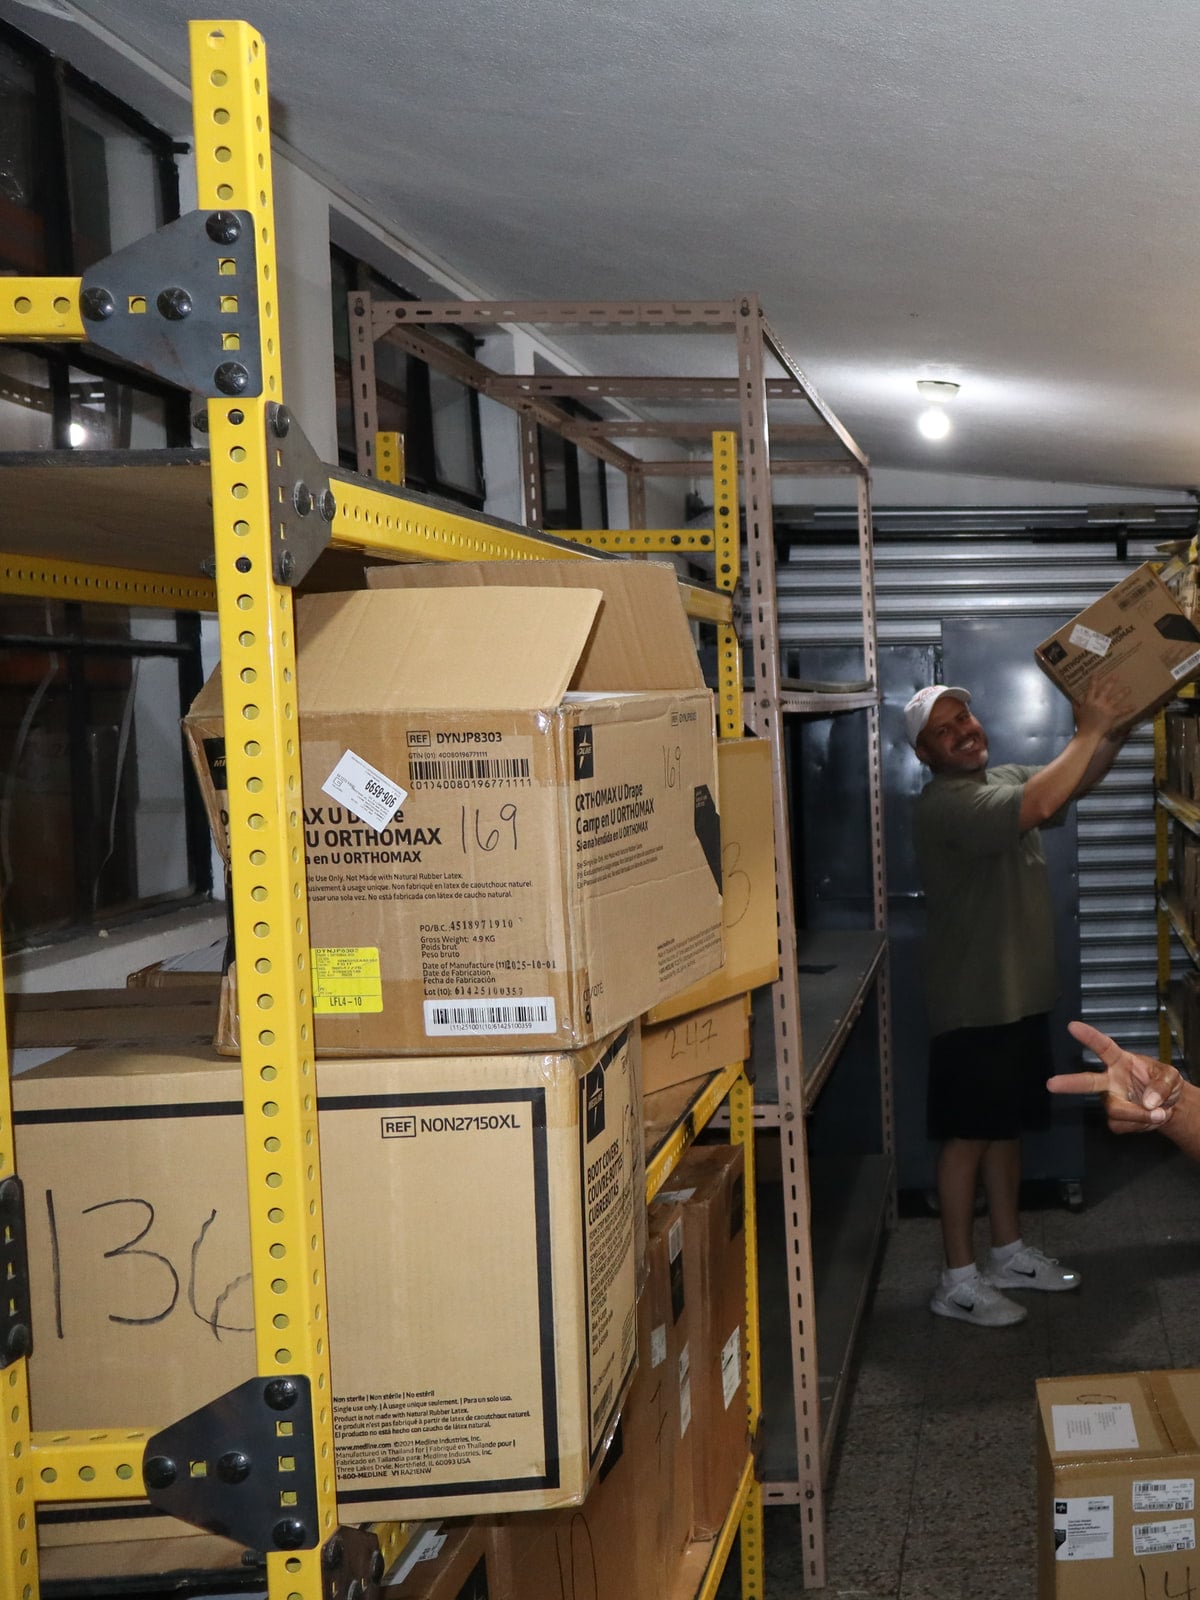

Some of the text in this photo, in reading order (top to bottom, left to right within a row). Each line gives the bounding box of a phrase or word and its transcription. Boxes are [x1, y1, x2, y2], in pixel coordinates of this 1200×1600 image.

[410, 732, 502, 744] REF DYNJP8303
[663, 745, 681, 790] 169
[410, 779, 531, 790] (01)40080196771111
[624, 784, 642, 800] Drape
[576, 817, 600, 834] Camp
[611, 808, 615, 825] U
[617, 798, 654, 823] ORTHOMAX
[462, 804, 517, 853] 169
[623, 820, 648, 837] ORTHOMAX
[306, 828, 442, 847] U ORTHOMAX
[313, 855, 328, 864] en
[331, 852, 340, 864] U
[344, 851, 422, 864] ORTHOMAX
[406, 883, 433, 891] fabriqué
[451, 920, 513, 931] 4518971910
[442, 936, 469, 944] Weight:
[665, 1019, 718, 1060] 247
[386, 1114, 520, 1133] REF NON27150XL
[588, 1157, 602, 1185] BOOT
[440, 1436, 470, 1444] Industries,
